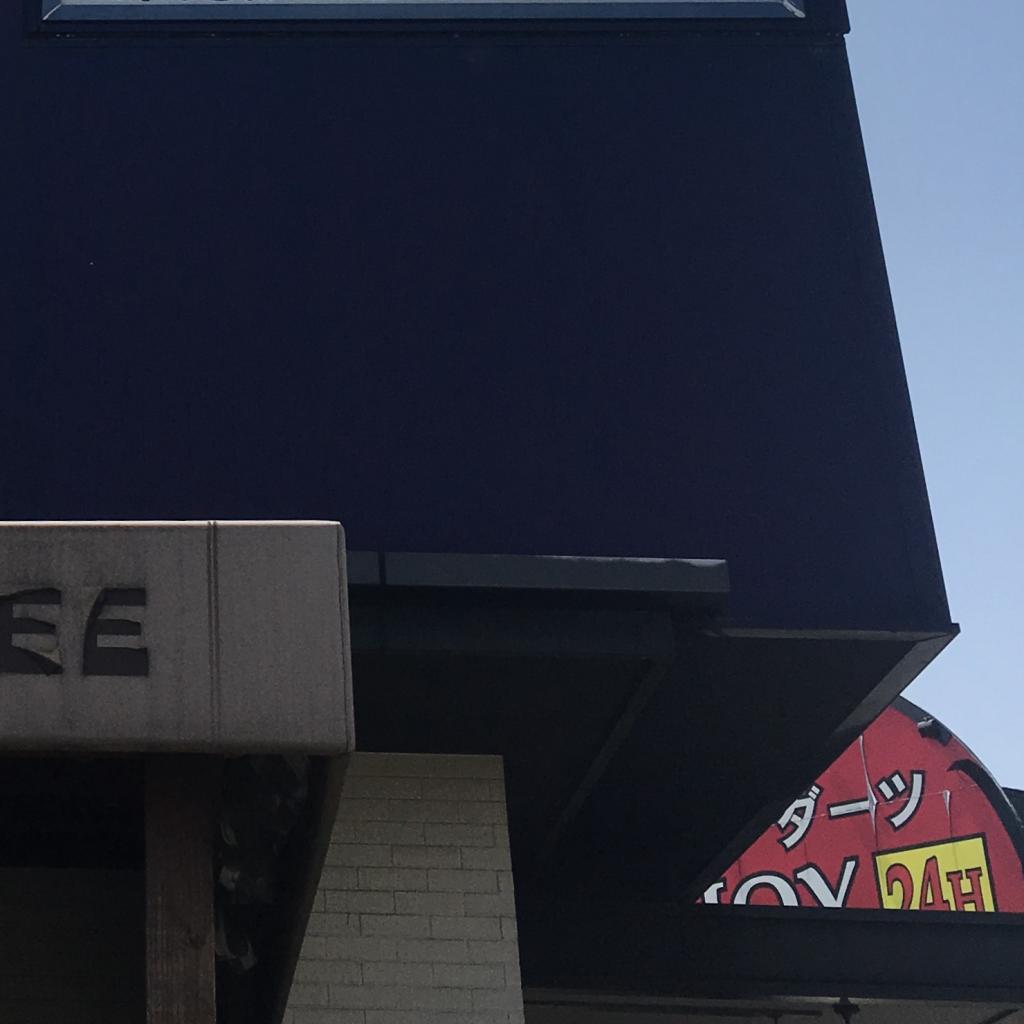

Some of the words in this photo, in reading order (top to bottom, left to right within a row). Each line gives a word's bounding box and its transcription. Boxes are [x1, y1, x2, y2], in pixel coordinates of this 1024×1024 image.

[776, 771, 925, 850] ダーツ
[884, 854, 985, 912] 24H
